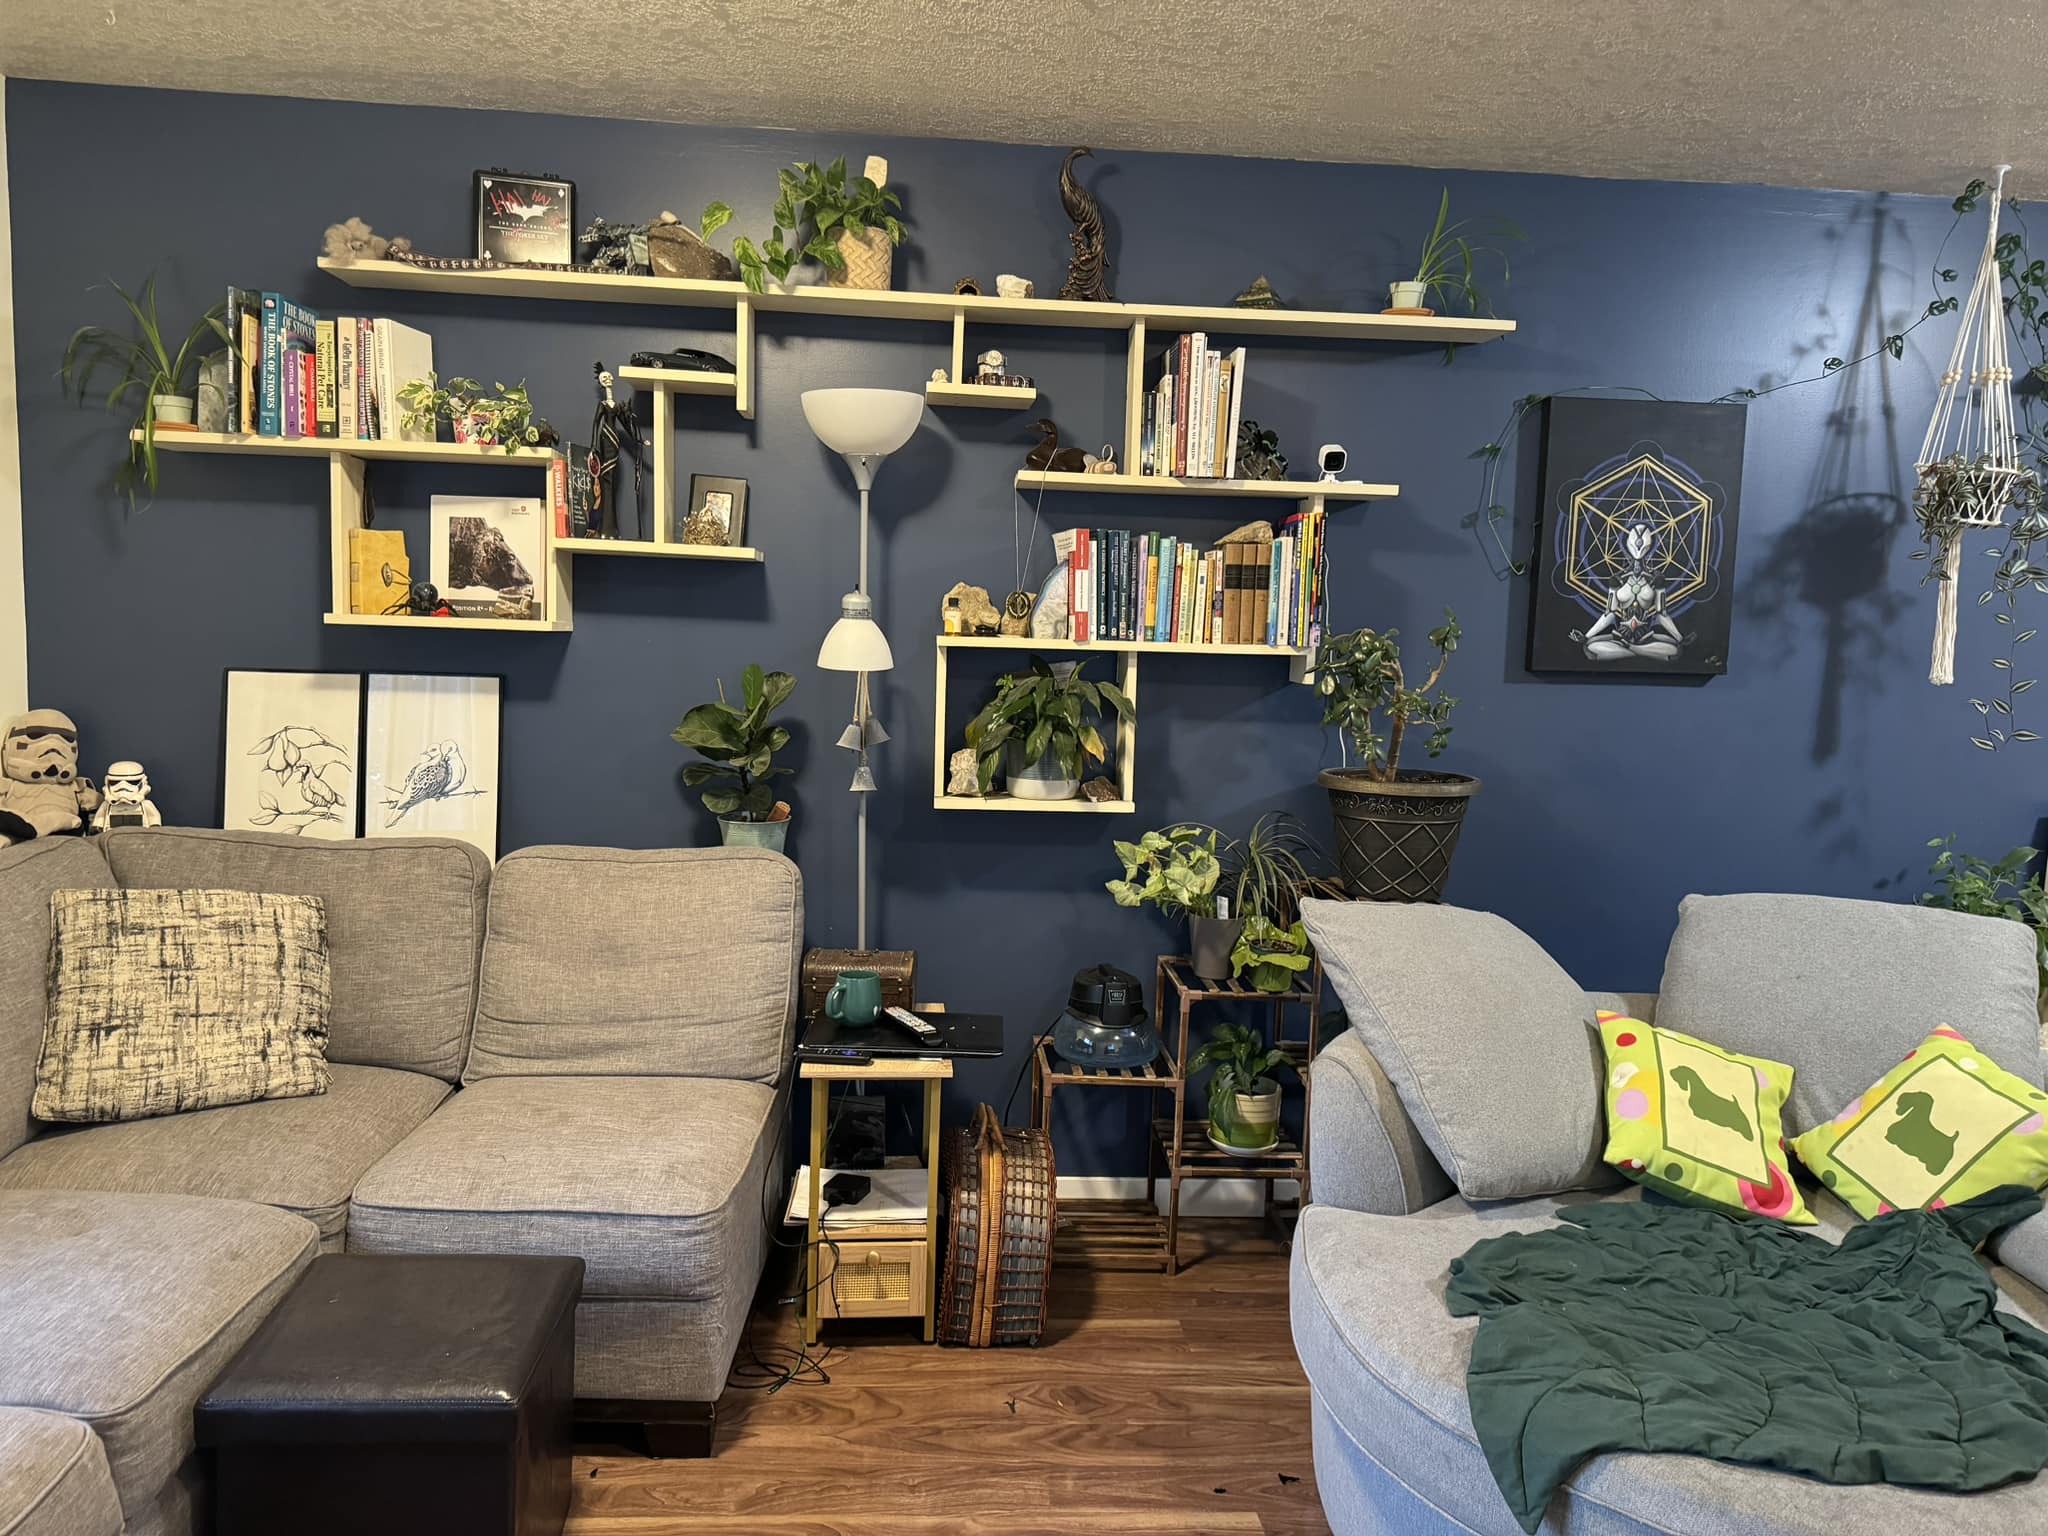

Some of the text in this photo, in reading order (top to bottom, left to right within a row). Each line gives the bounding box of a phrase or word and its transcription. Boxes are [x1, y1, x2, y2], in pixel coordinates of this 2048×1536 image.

[283, 301, 297, 319] THE
[266, 312, 276, 409] THE BOOK OF STONES
[317, 342, 326, 409] Natural Pet Care
